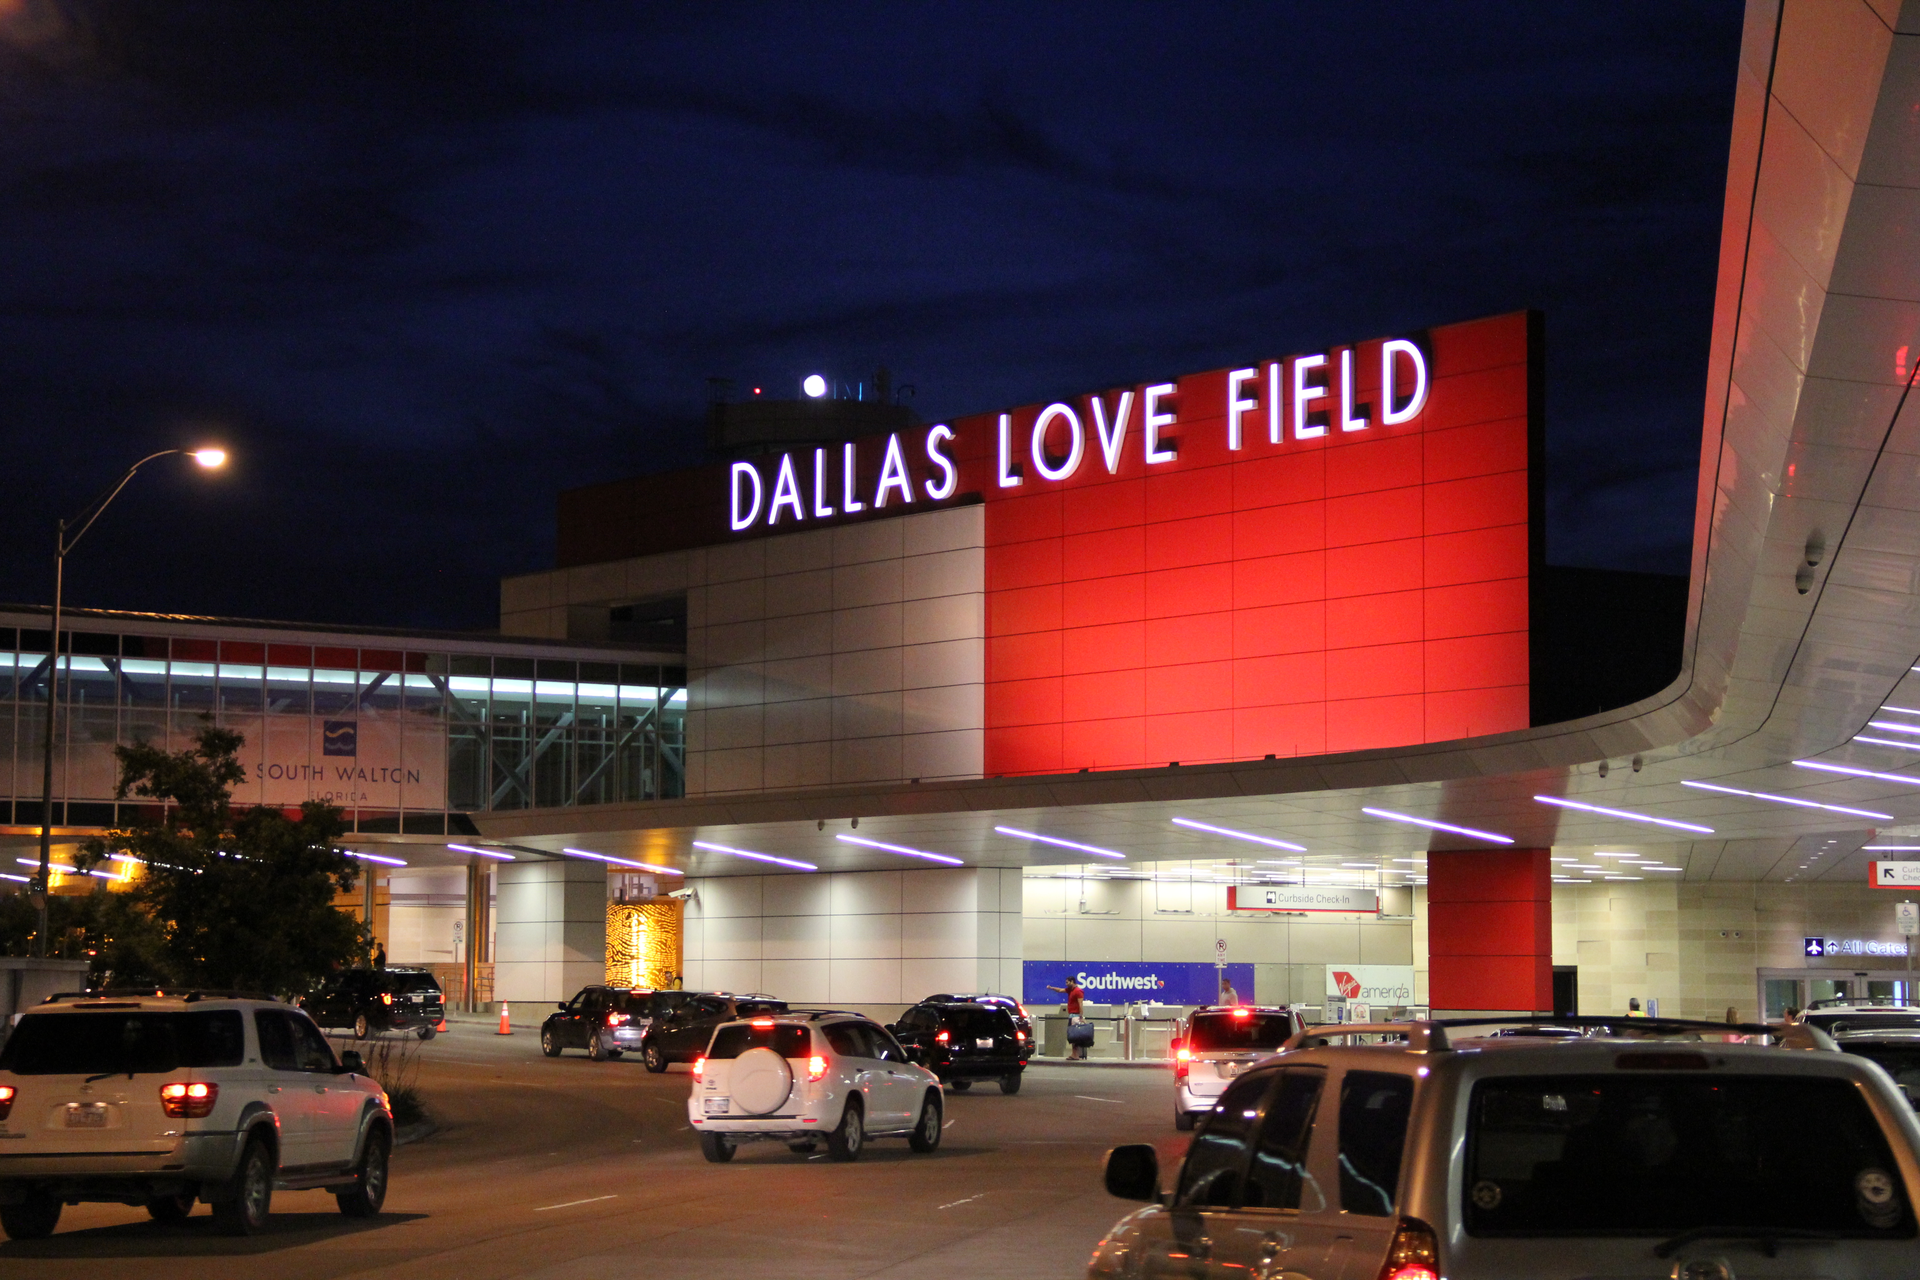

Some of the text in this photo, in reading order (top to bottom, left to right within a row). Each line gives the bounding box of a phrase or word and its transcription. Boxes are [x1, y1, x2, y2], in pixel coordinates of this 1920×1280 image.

[731, 339, 1430, 531] DALLAS LOVE FIELD
[256, 763, 420, 784] SOUTH WALTON
[1278, 893, 1350, 904] Curbside Check-In
[1842, 940, 1908, 955] All Gates
[1076, 971, 1158, 990] Southwest
[1361, 985, 1410, 999] america
